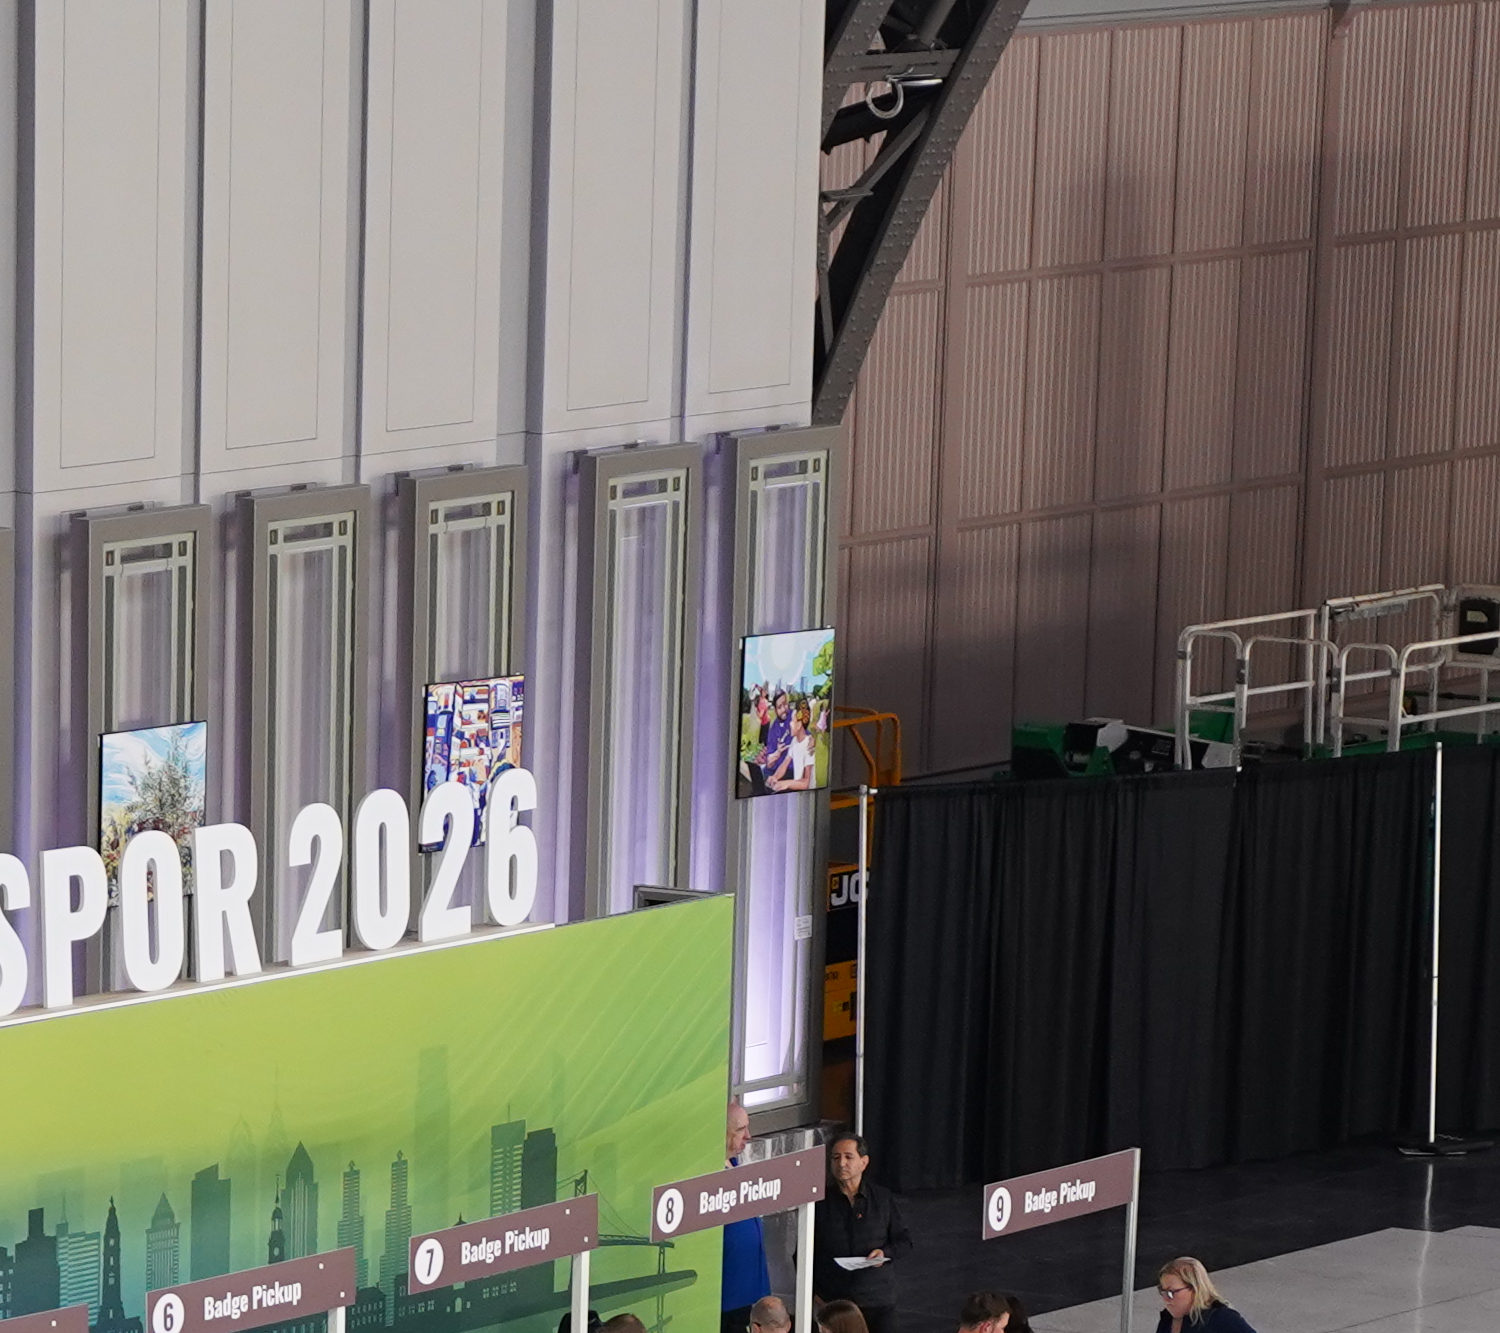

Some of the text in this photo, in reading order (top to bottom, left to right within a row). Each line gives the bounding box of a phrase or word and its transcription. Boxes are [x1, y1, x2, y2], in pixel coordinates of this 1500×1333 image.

[288, 768, 539, 967] 2026
[830, 871, 870, 906] JC
[666, 1176, 781, 1224] 8 Badge Pickup
[997, 1179, 1095, 1222] 9 Badge Pickup
[426, 1226, 550, 1276] 7 Badge Pickup
[163, 1281, 302, 1331] 6 Badge Pickup
